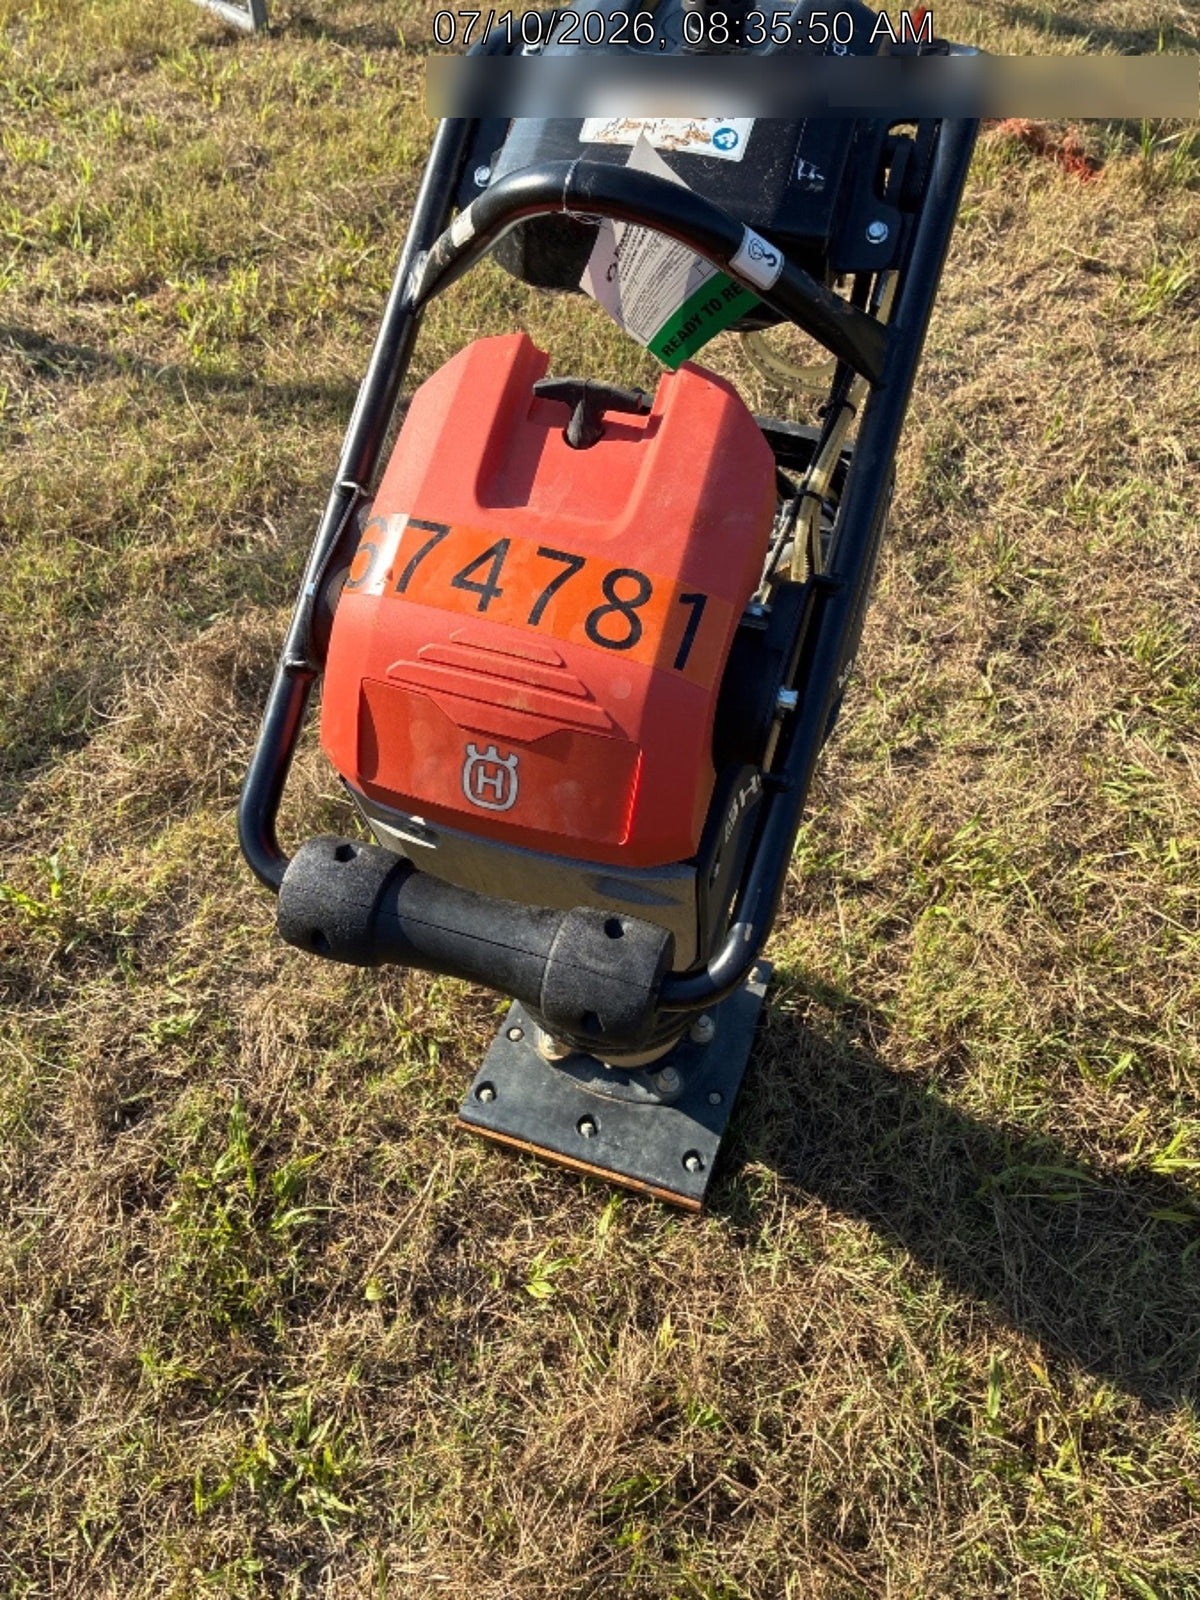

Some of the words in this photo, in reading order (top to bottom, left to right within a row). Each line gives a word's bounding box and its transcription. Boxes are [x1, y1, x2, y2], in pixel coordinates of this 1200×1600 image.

[661, 313, 703, 357] READY
[701, 298, 723, 317] TO
[346, 515, 708, 671] 674781
